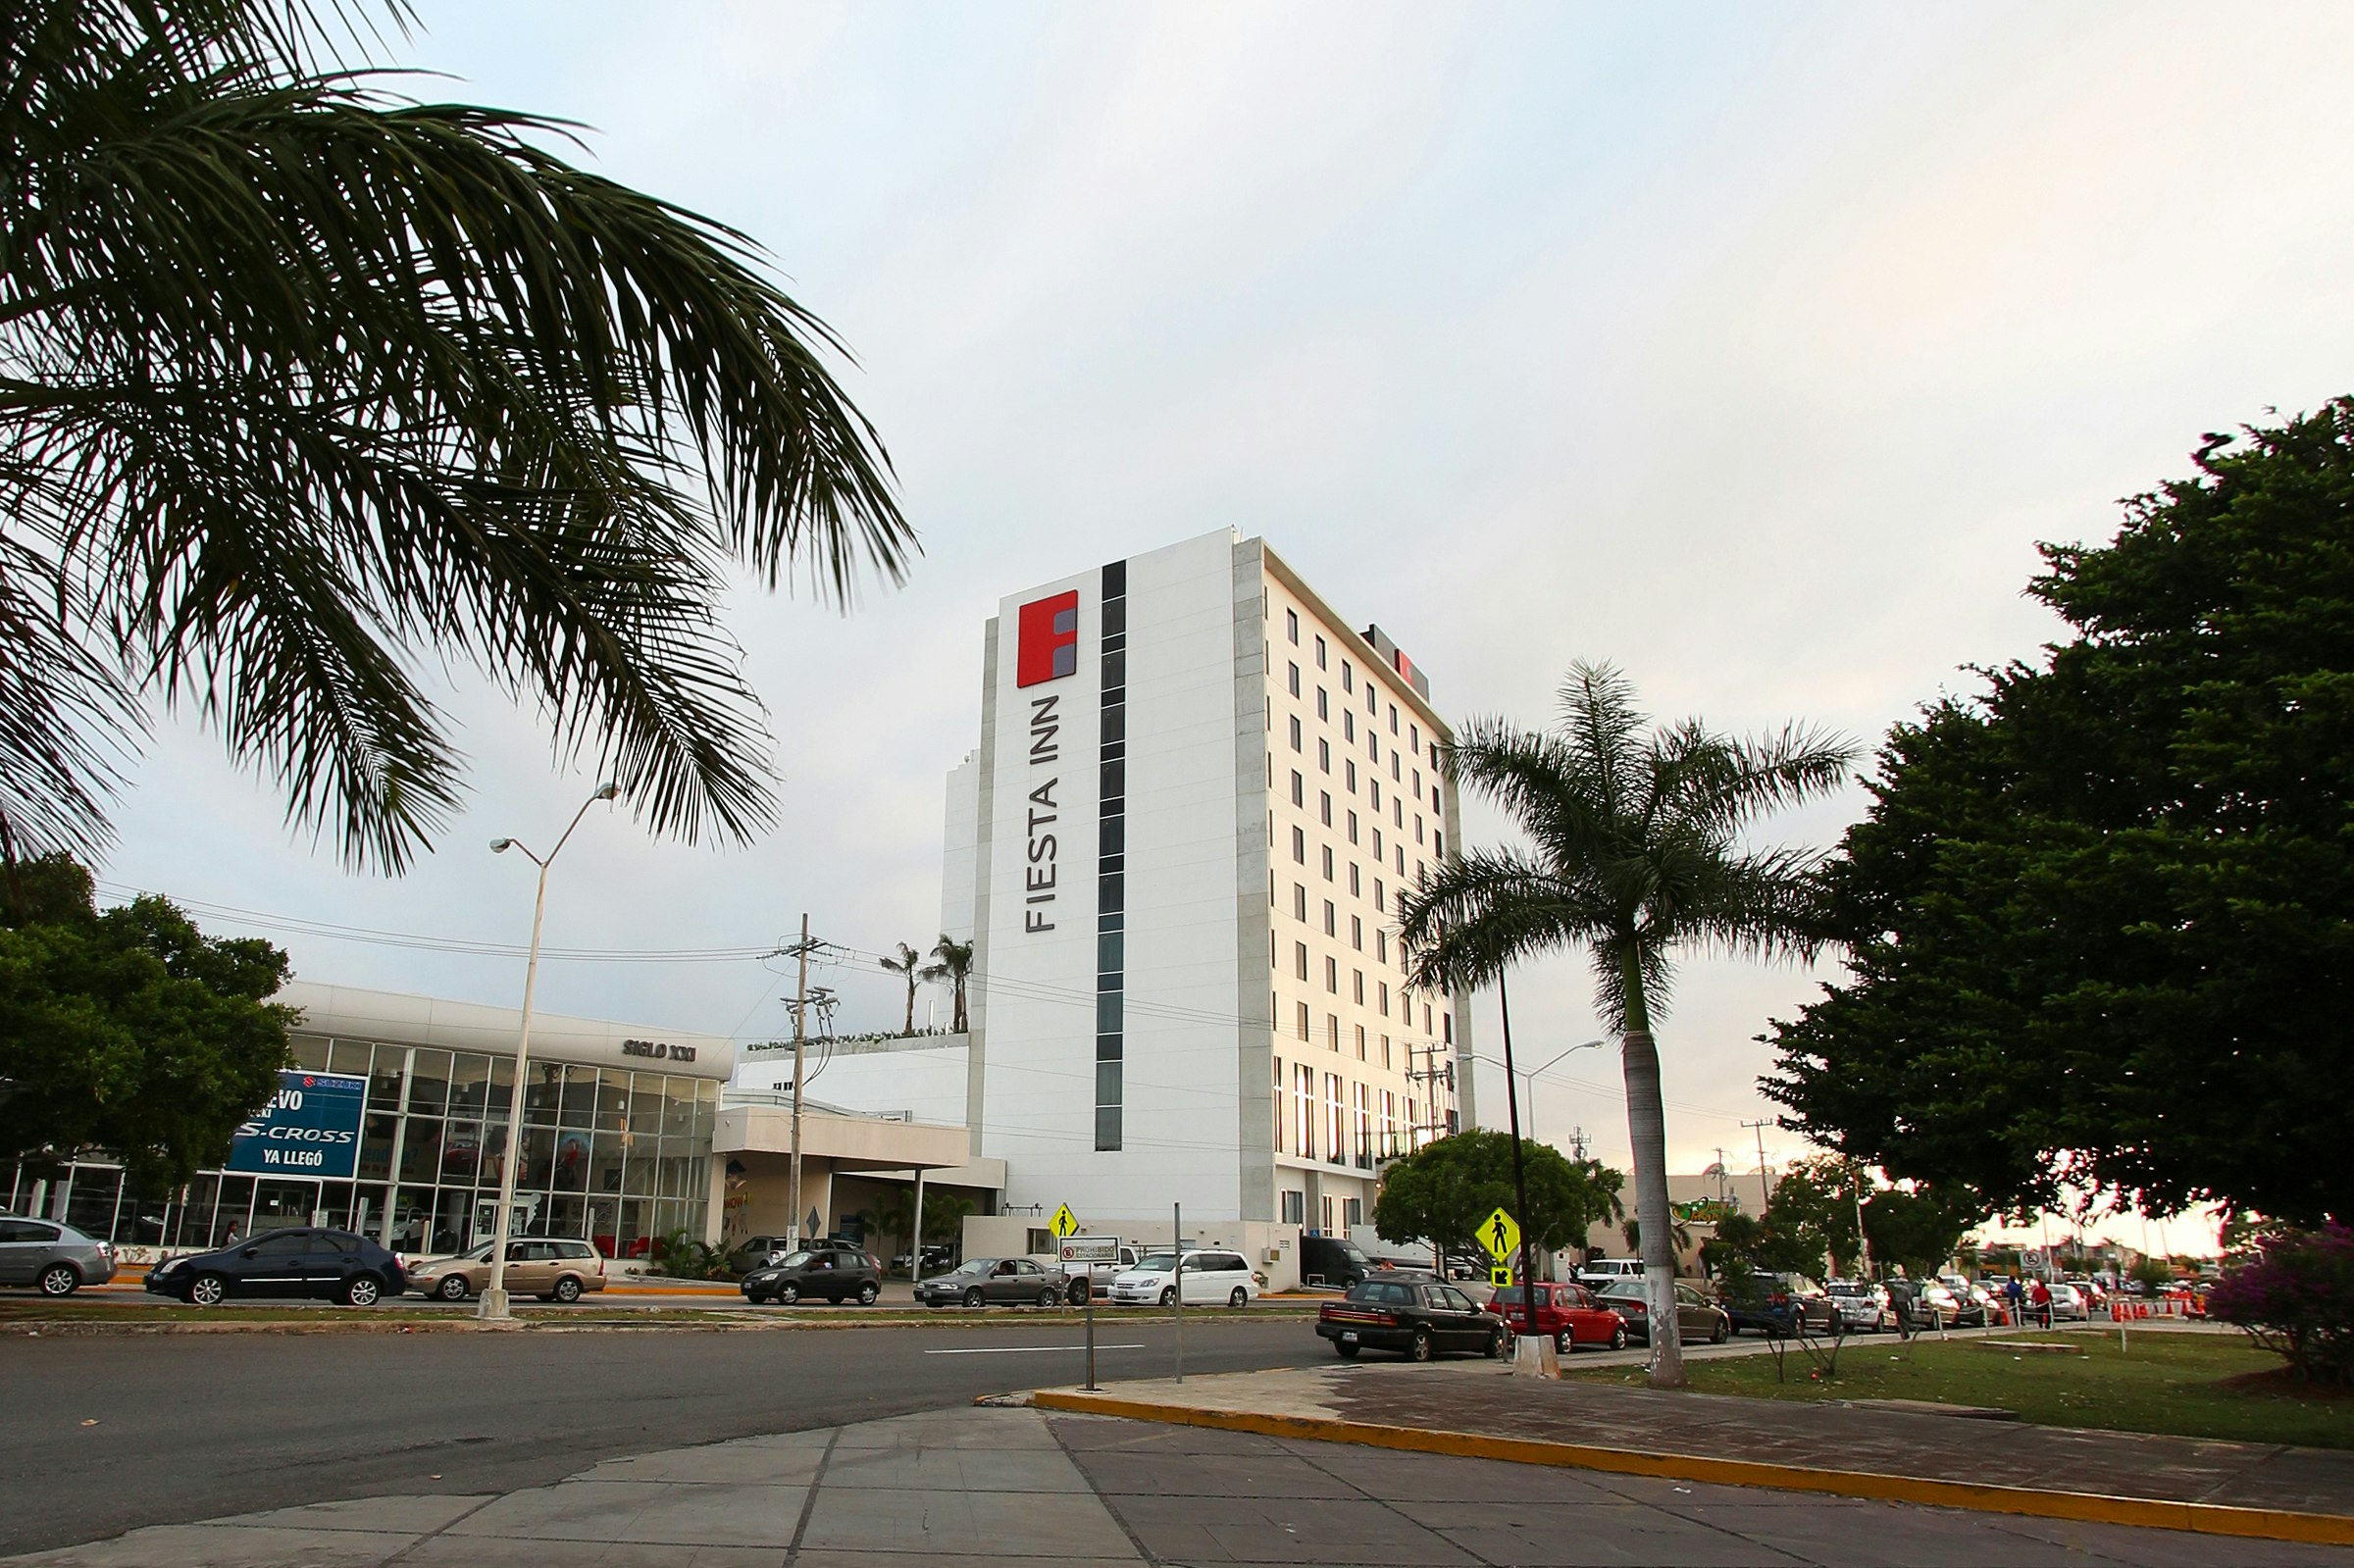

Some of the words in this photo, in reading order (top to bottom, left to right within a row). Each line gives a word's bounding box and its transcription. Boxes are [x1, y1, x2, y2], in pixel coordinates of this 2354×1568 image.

[1030, 695, 1059, 765] INN
[1025, 778, 1058, 934] FIESTA
[623, 1039, 667, 1058] SIGLO
[669, 1044, 696, 1062] XXI
[317, 1079, 362, 1090] SUZUKI
[234, 1122, 355, 1143] S-CROSS
[263, 1149, 280, 1164] YA
[282, 1149, 324, 1167] LLEGÓ
